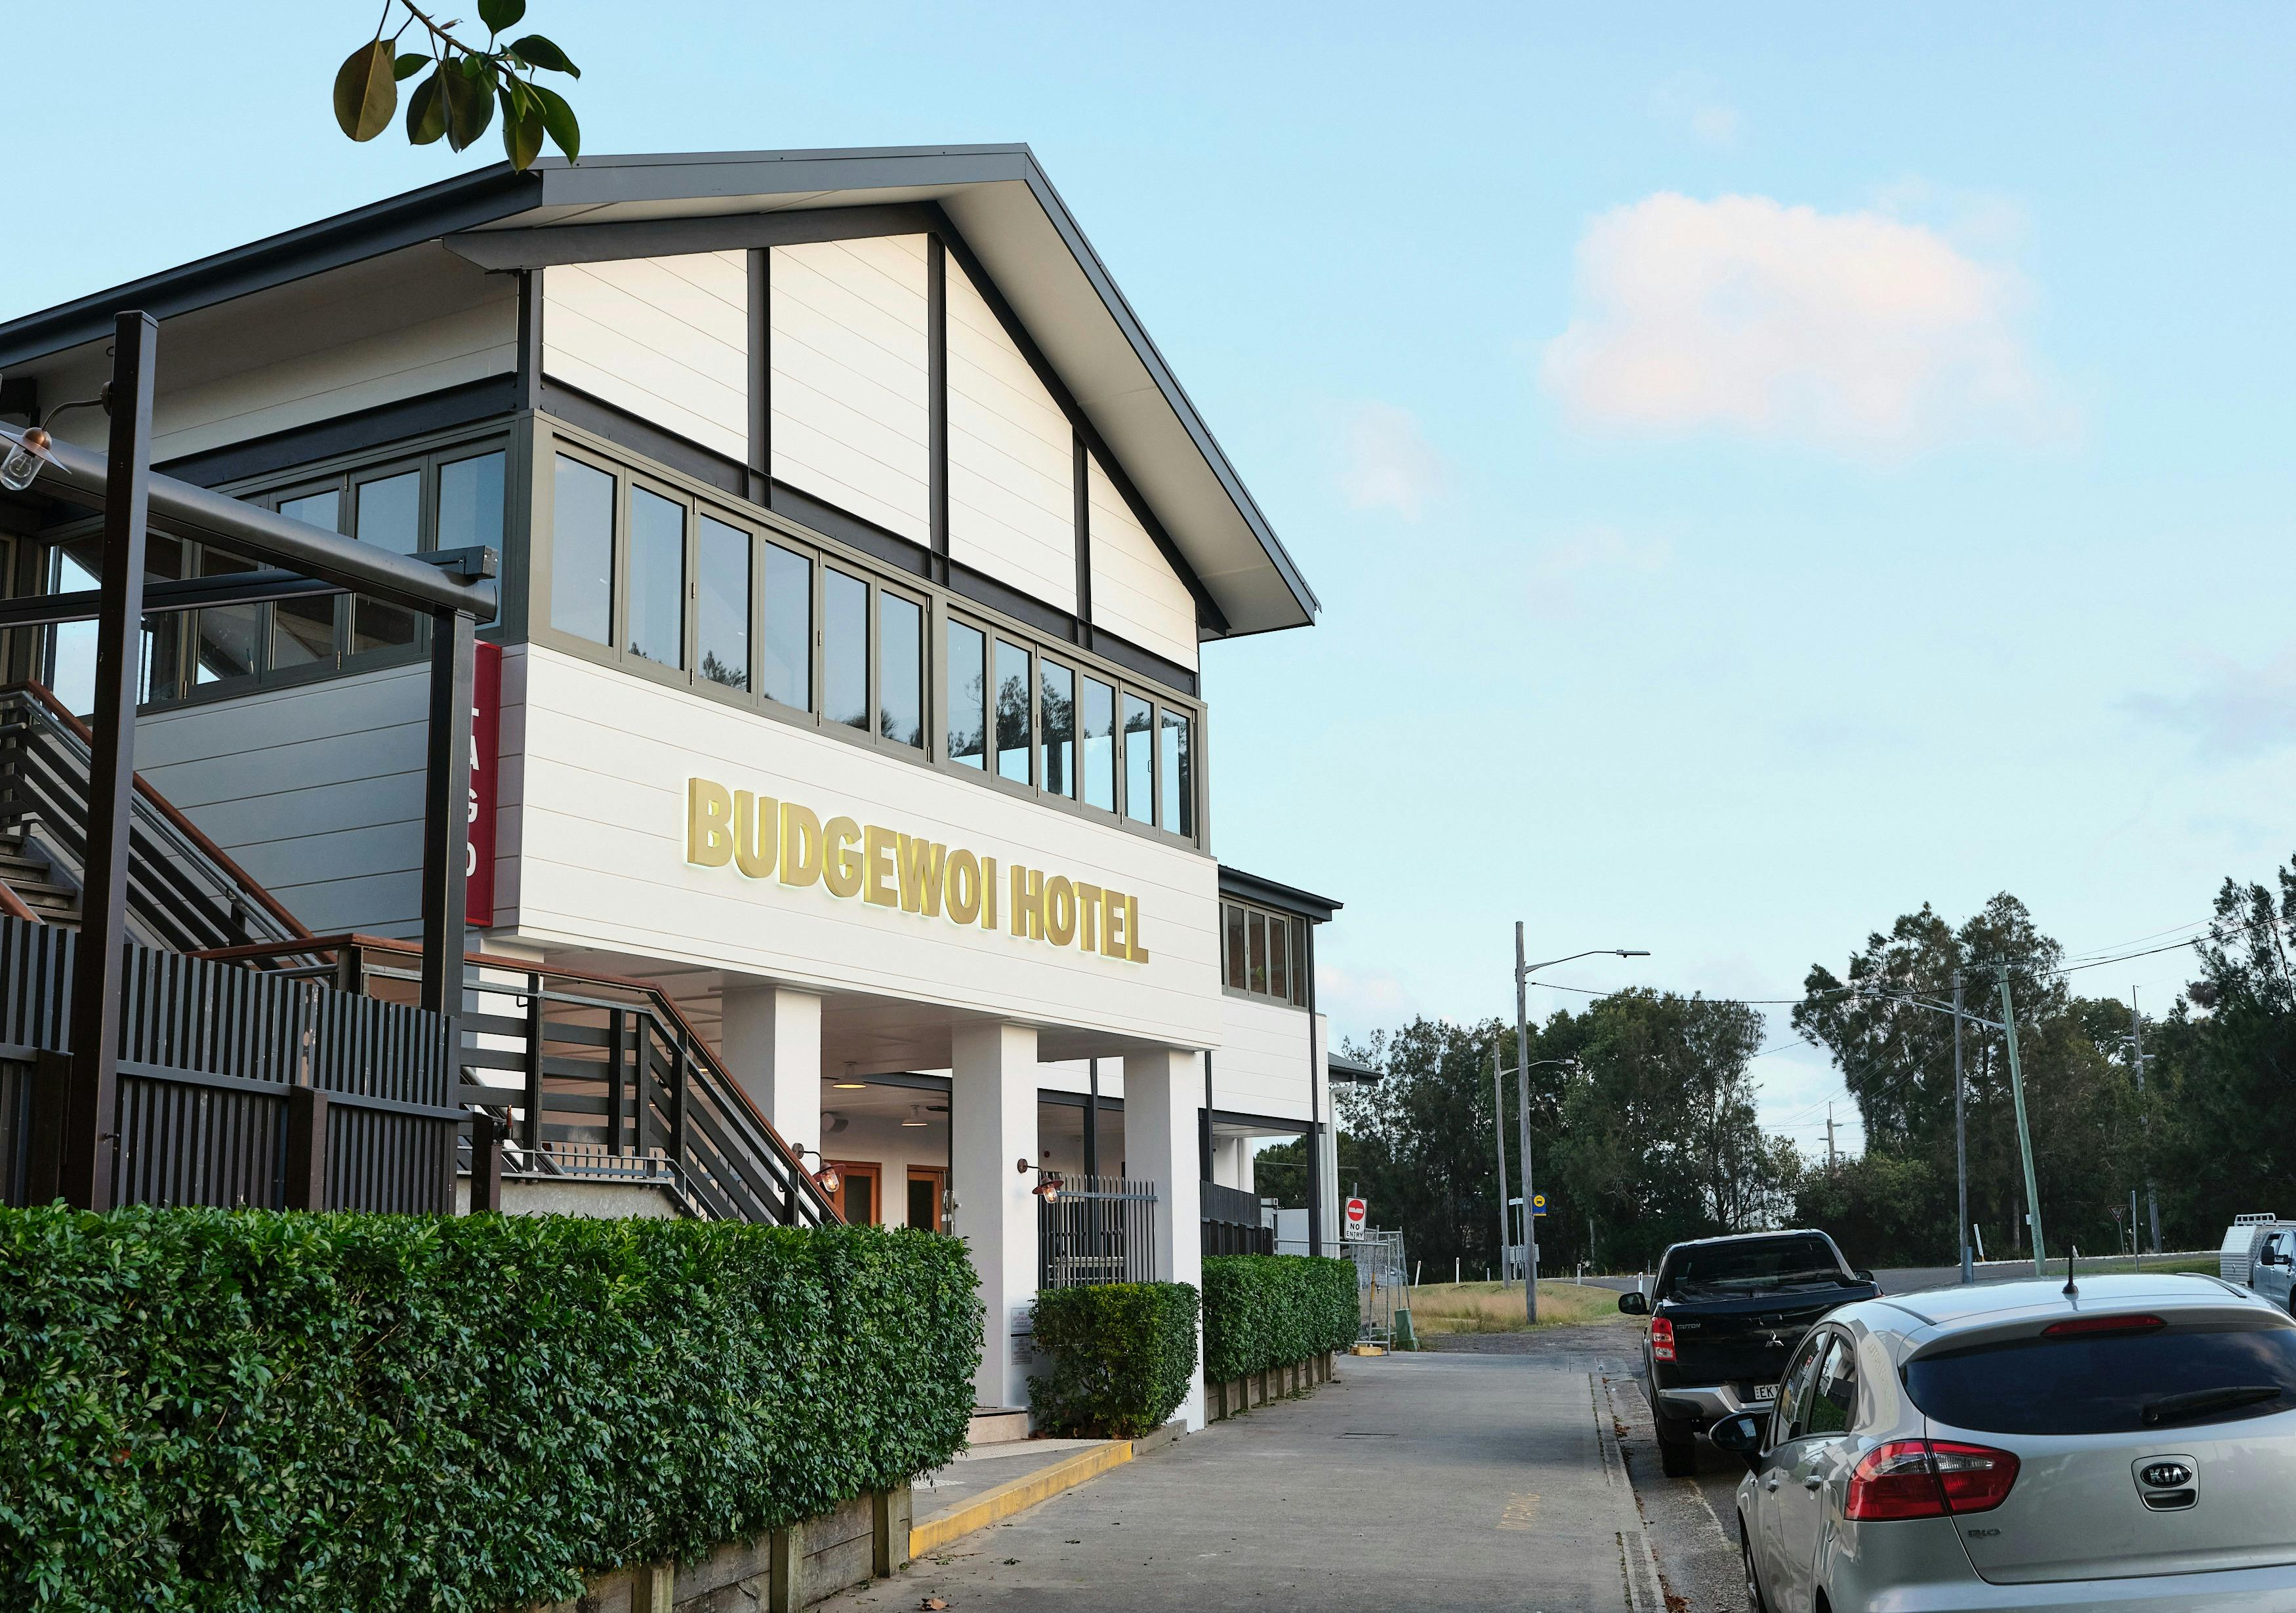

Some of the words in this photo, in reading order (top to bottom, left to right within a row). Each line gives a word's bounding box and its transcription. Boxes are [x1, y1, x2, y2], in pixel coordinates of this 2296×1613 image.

[687, 777, 997, 930] BUDGEWOI
[1010, 865, 1149, 964] HOTEL
[2148, 1467, 2185, 1483] KIA
[1968, 1528, 2001, 1538] RIO
